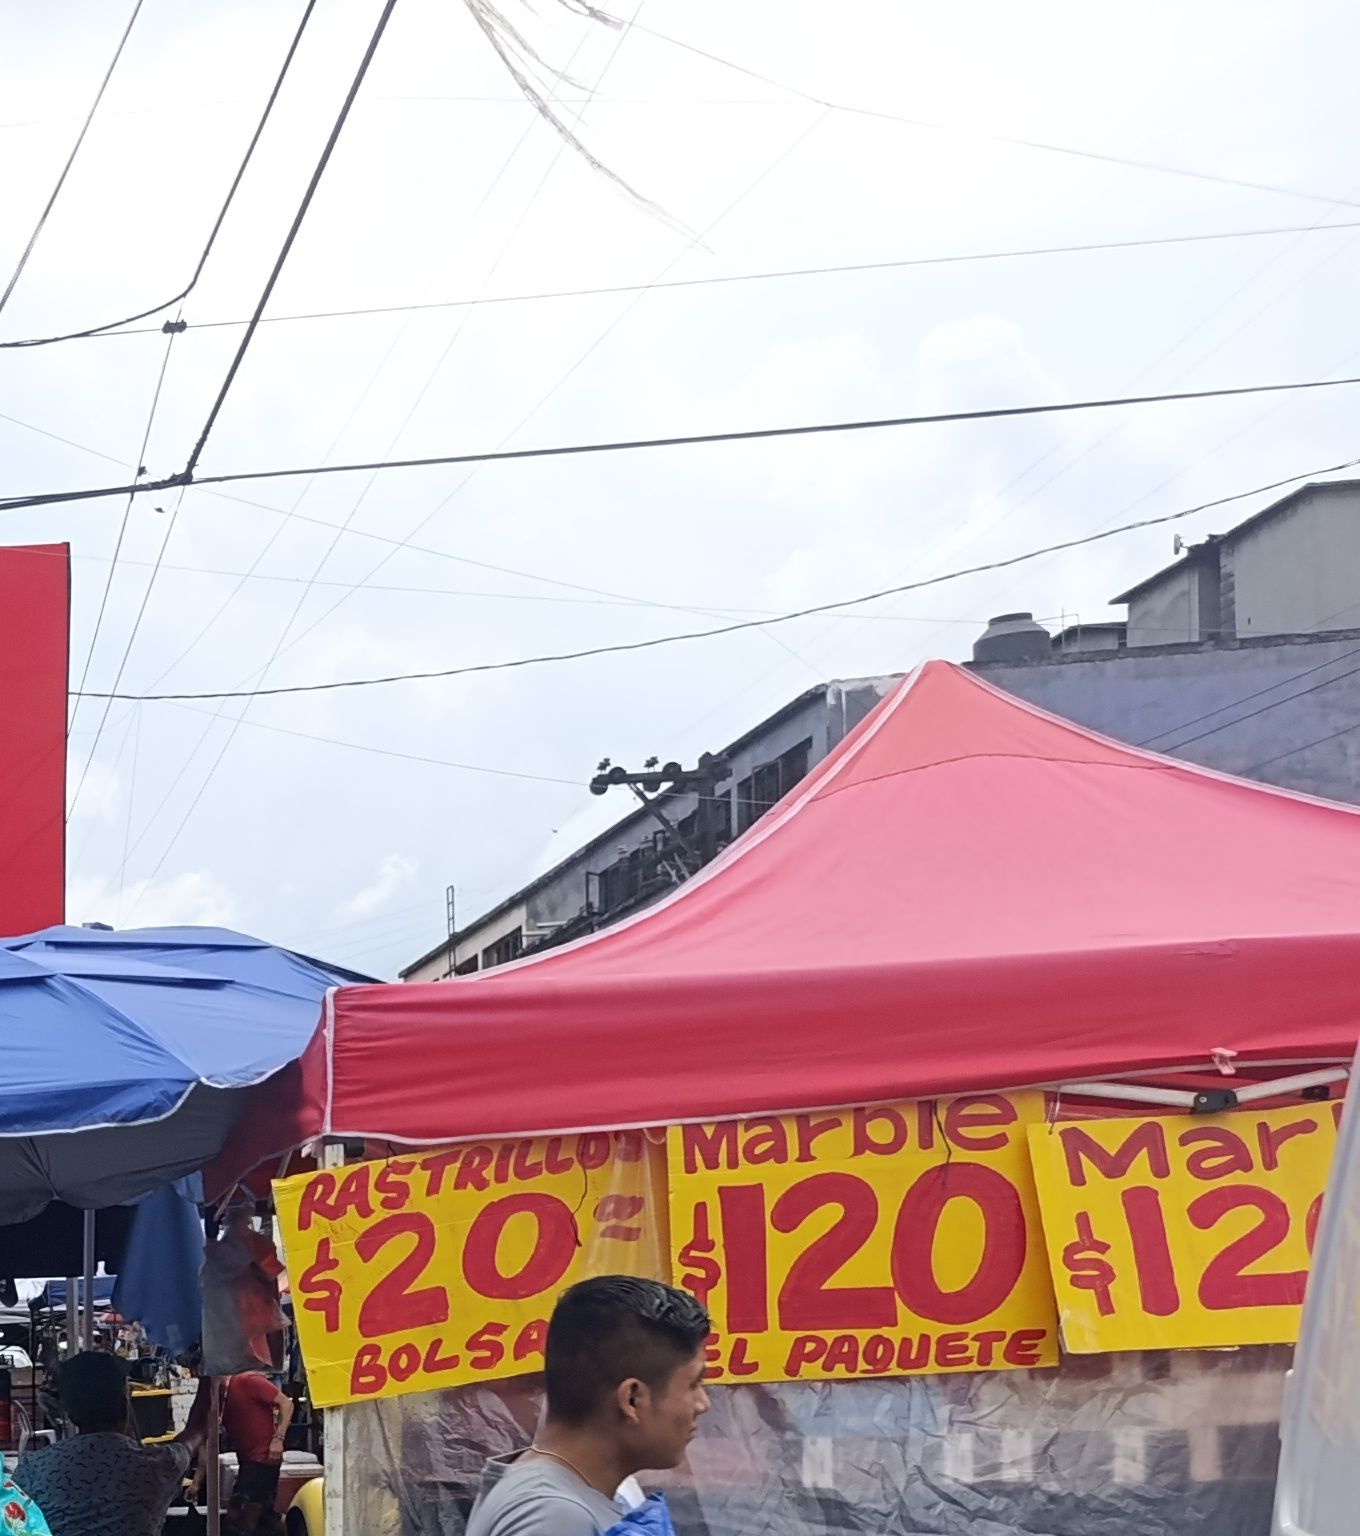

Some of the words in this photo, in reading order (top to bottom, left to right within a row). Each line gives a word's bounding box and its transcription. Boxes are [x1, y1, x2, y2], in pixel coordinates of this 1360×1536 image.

[682, 1094, 1019, 1175] Marble
[1058, 1102, 1344, 1188] Mar
[678, 1161, 1028, 1335] $120
[1061, 1183, 1326, 1317] $12
[350, 1318, 549, 1396] BOLSA
[701, 1332, 759, 1380] EL
[784, 1328, 1047, 1379] PAQUETE
